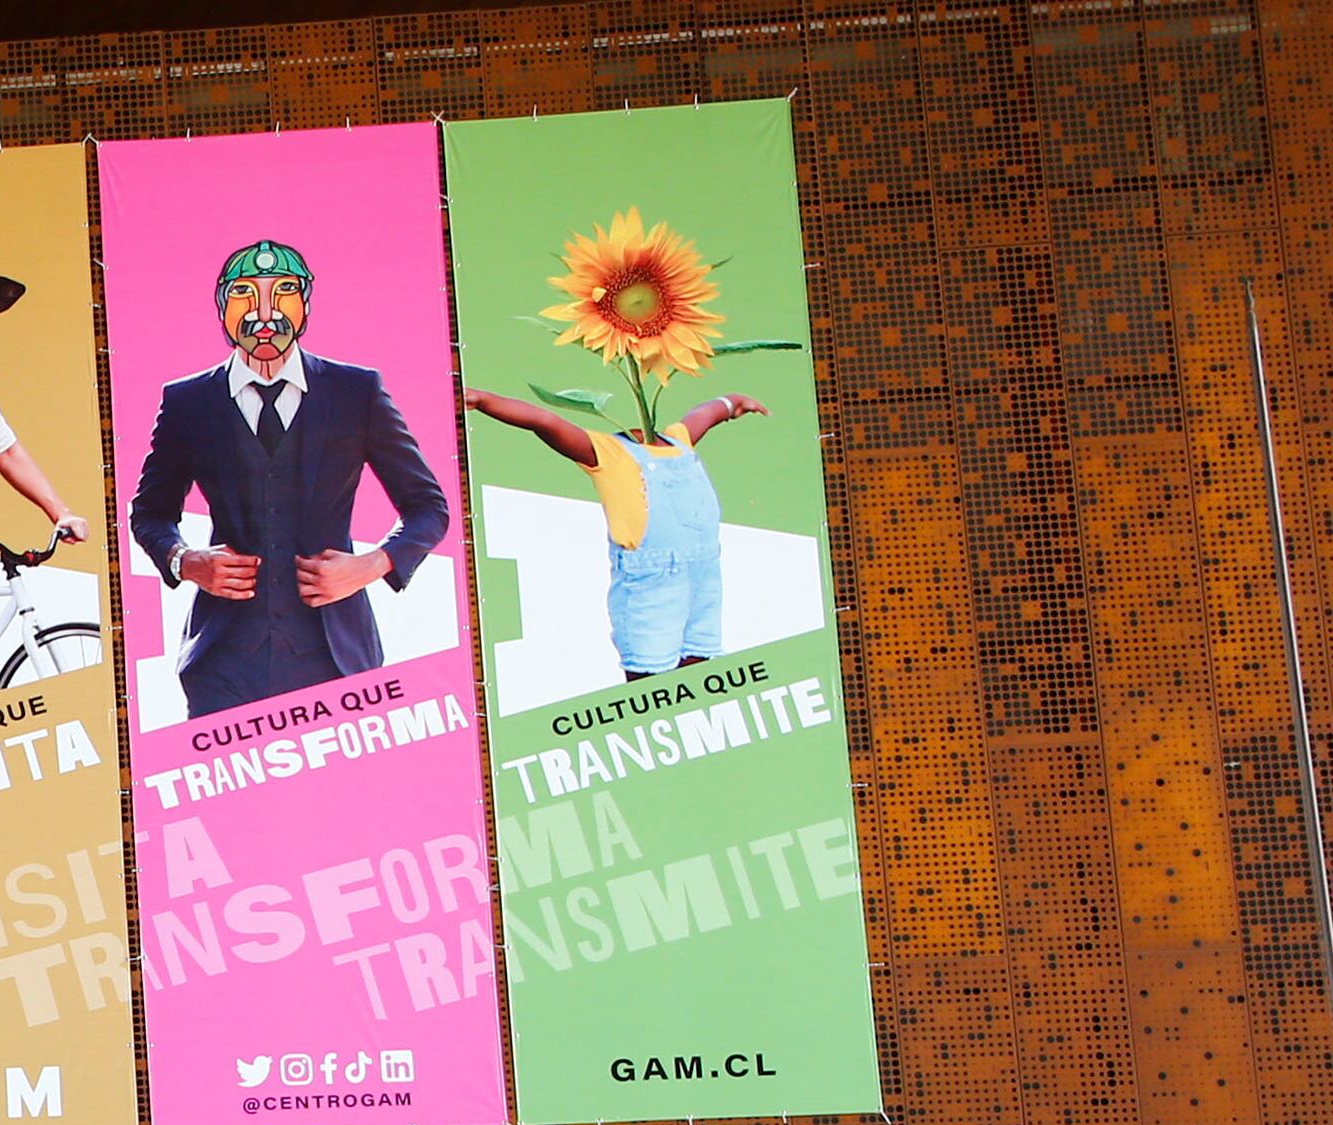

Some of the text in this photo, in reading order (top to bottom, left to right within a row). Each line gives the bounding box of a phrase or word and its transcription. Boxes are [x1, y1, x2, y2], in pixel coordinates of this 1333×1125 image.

[191, 679, 405, 752] CULTURA QUE
[552, 662, 769, 736] CULTURA QUE
[144, 694, 469, 810] TRANSFORMA
[501, 677, 832, 804] TRANSMITE
[242, 1093, 412, 1115] @CENTROGAM
[609, 1053, 776, 1082] GAM.CL
